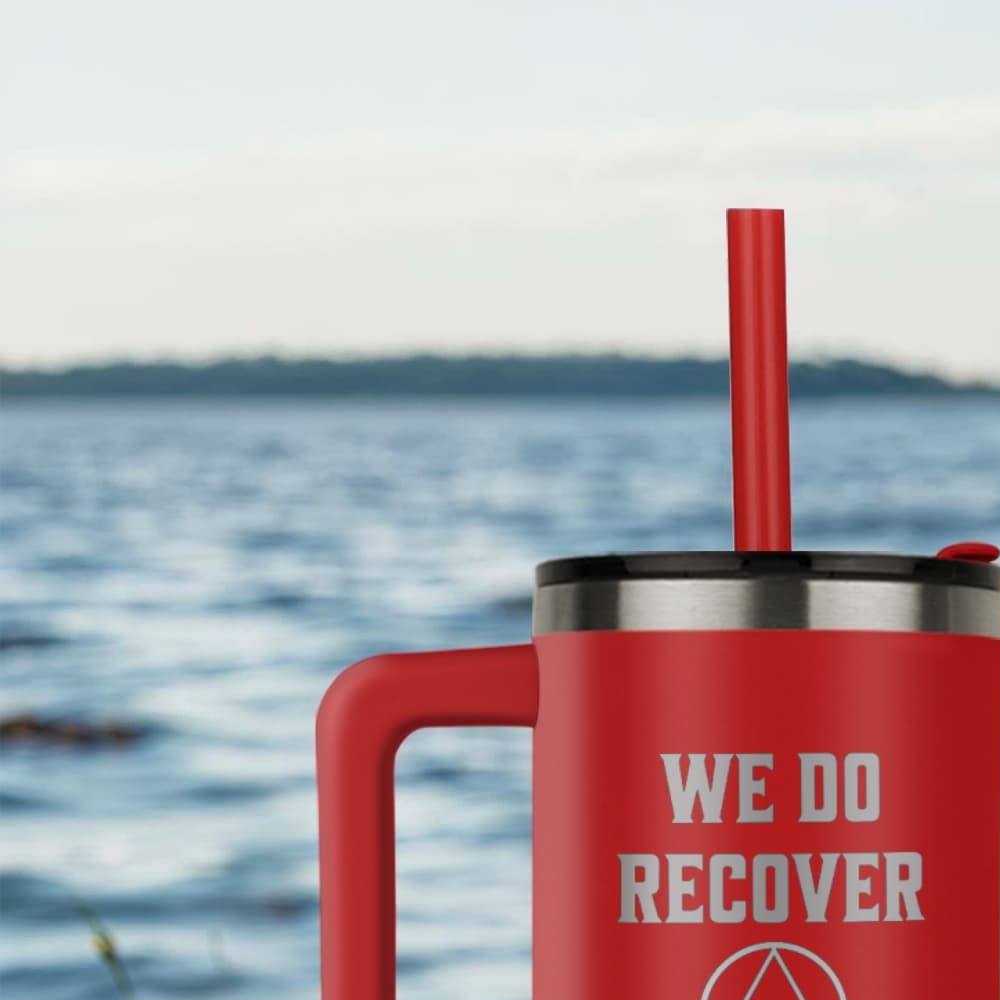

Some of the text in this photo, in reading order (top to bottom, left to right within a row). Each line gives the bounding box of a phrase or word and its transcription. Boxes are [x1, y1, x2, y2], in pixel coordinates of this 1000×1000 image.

[660, 752, 881, 824] WE DO
[617, 851, 925, 925] RECOVER
